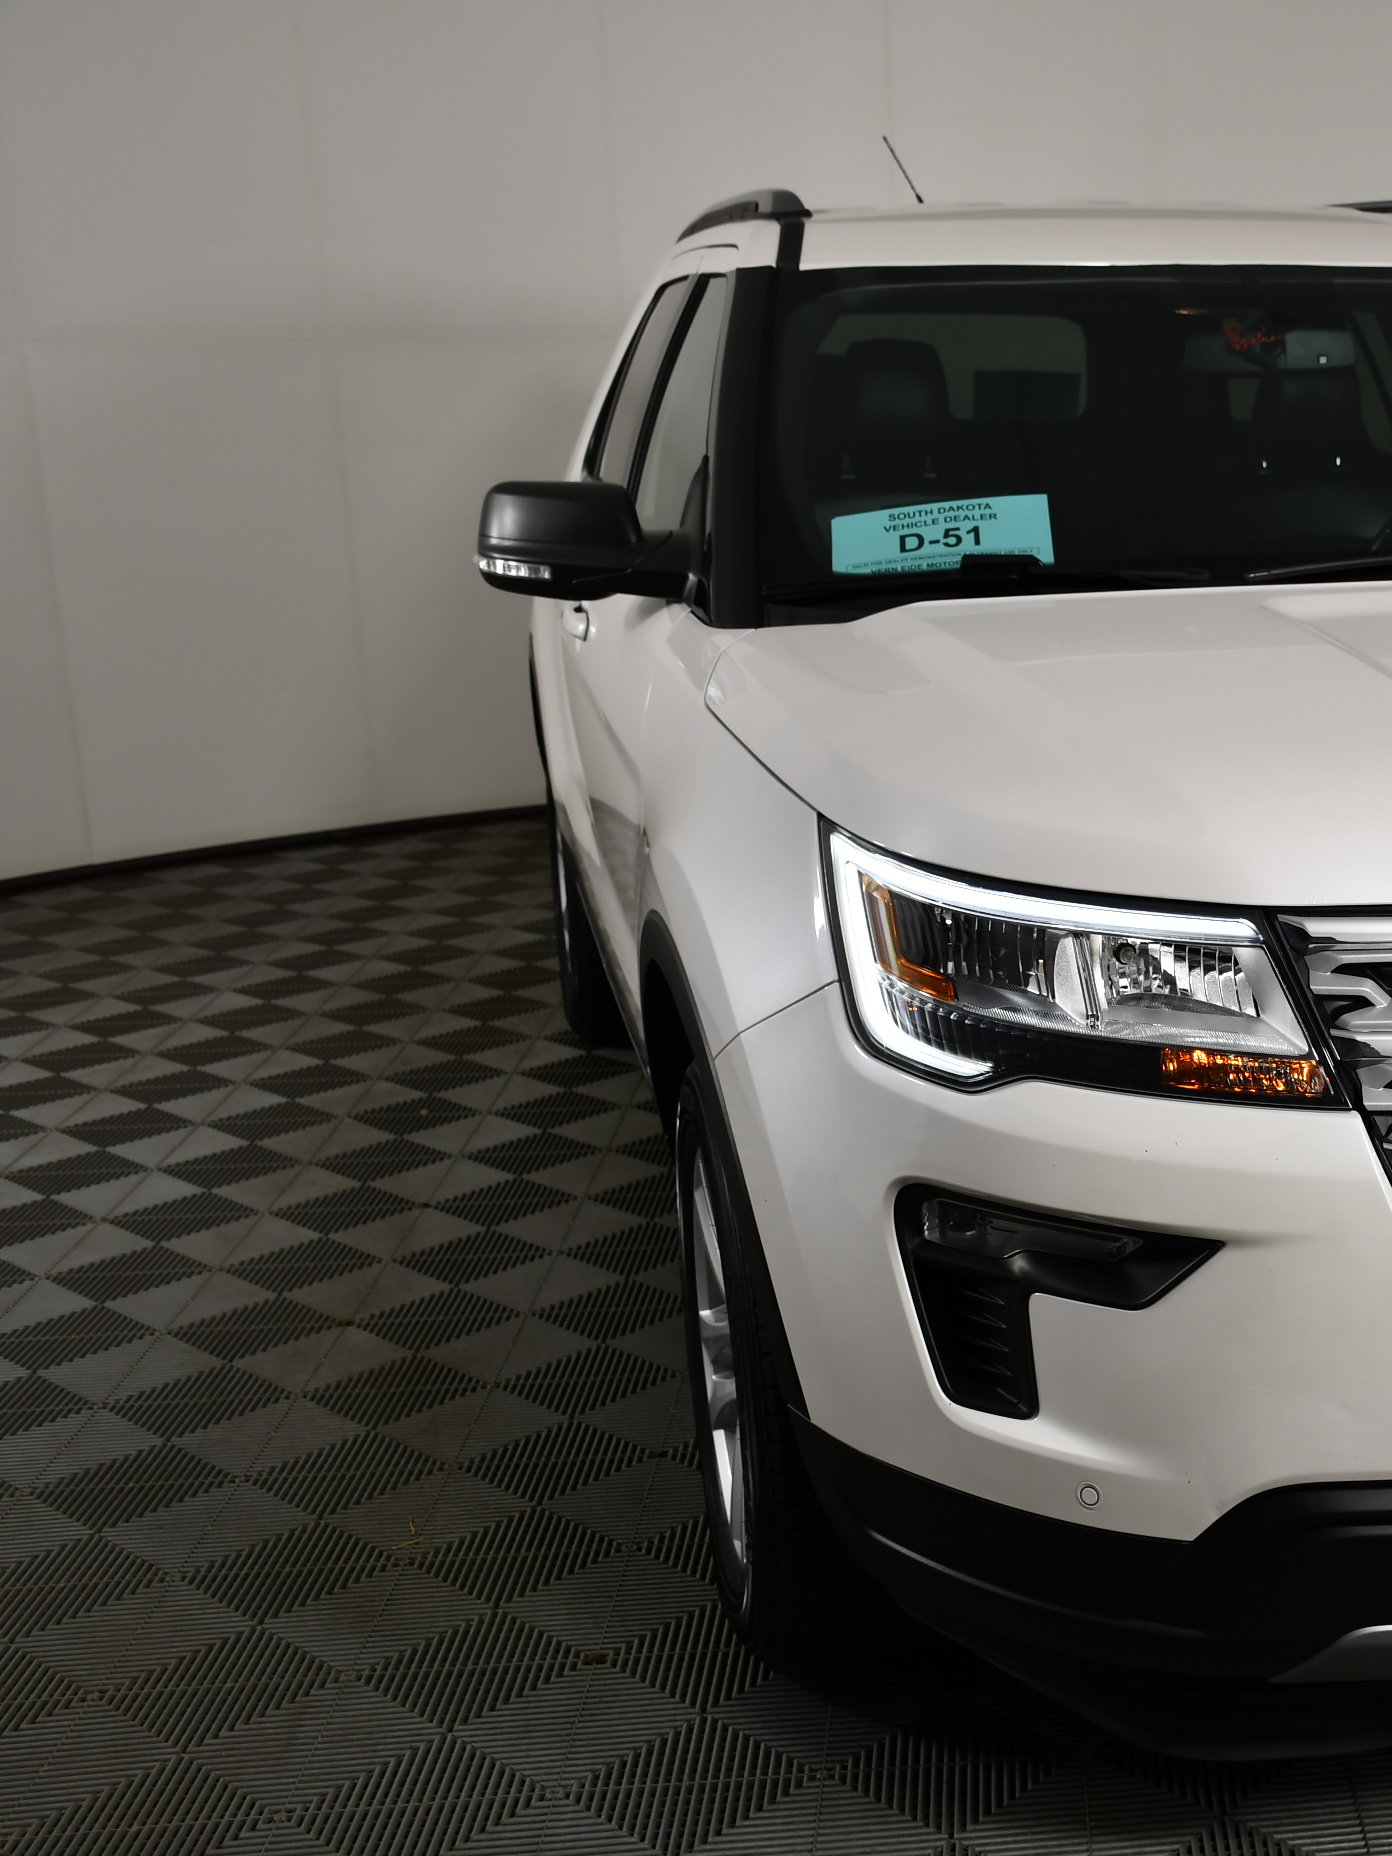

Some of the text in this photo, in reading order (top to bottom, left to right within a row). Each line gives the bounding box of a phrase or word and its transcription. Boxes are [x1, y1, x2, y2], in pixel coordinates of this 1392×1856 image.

[883, 512, 998, 533] VEHICLE DEALER
[888, 502, 993, 522] SOUTH DAKOTA
[899, 525, 982, 553] D-51
